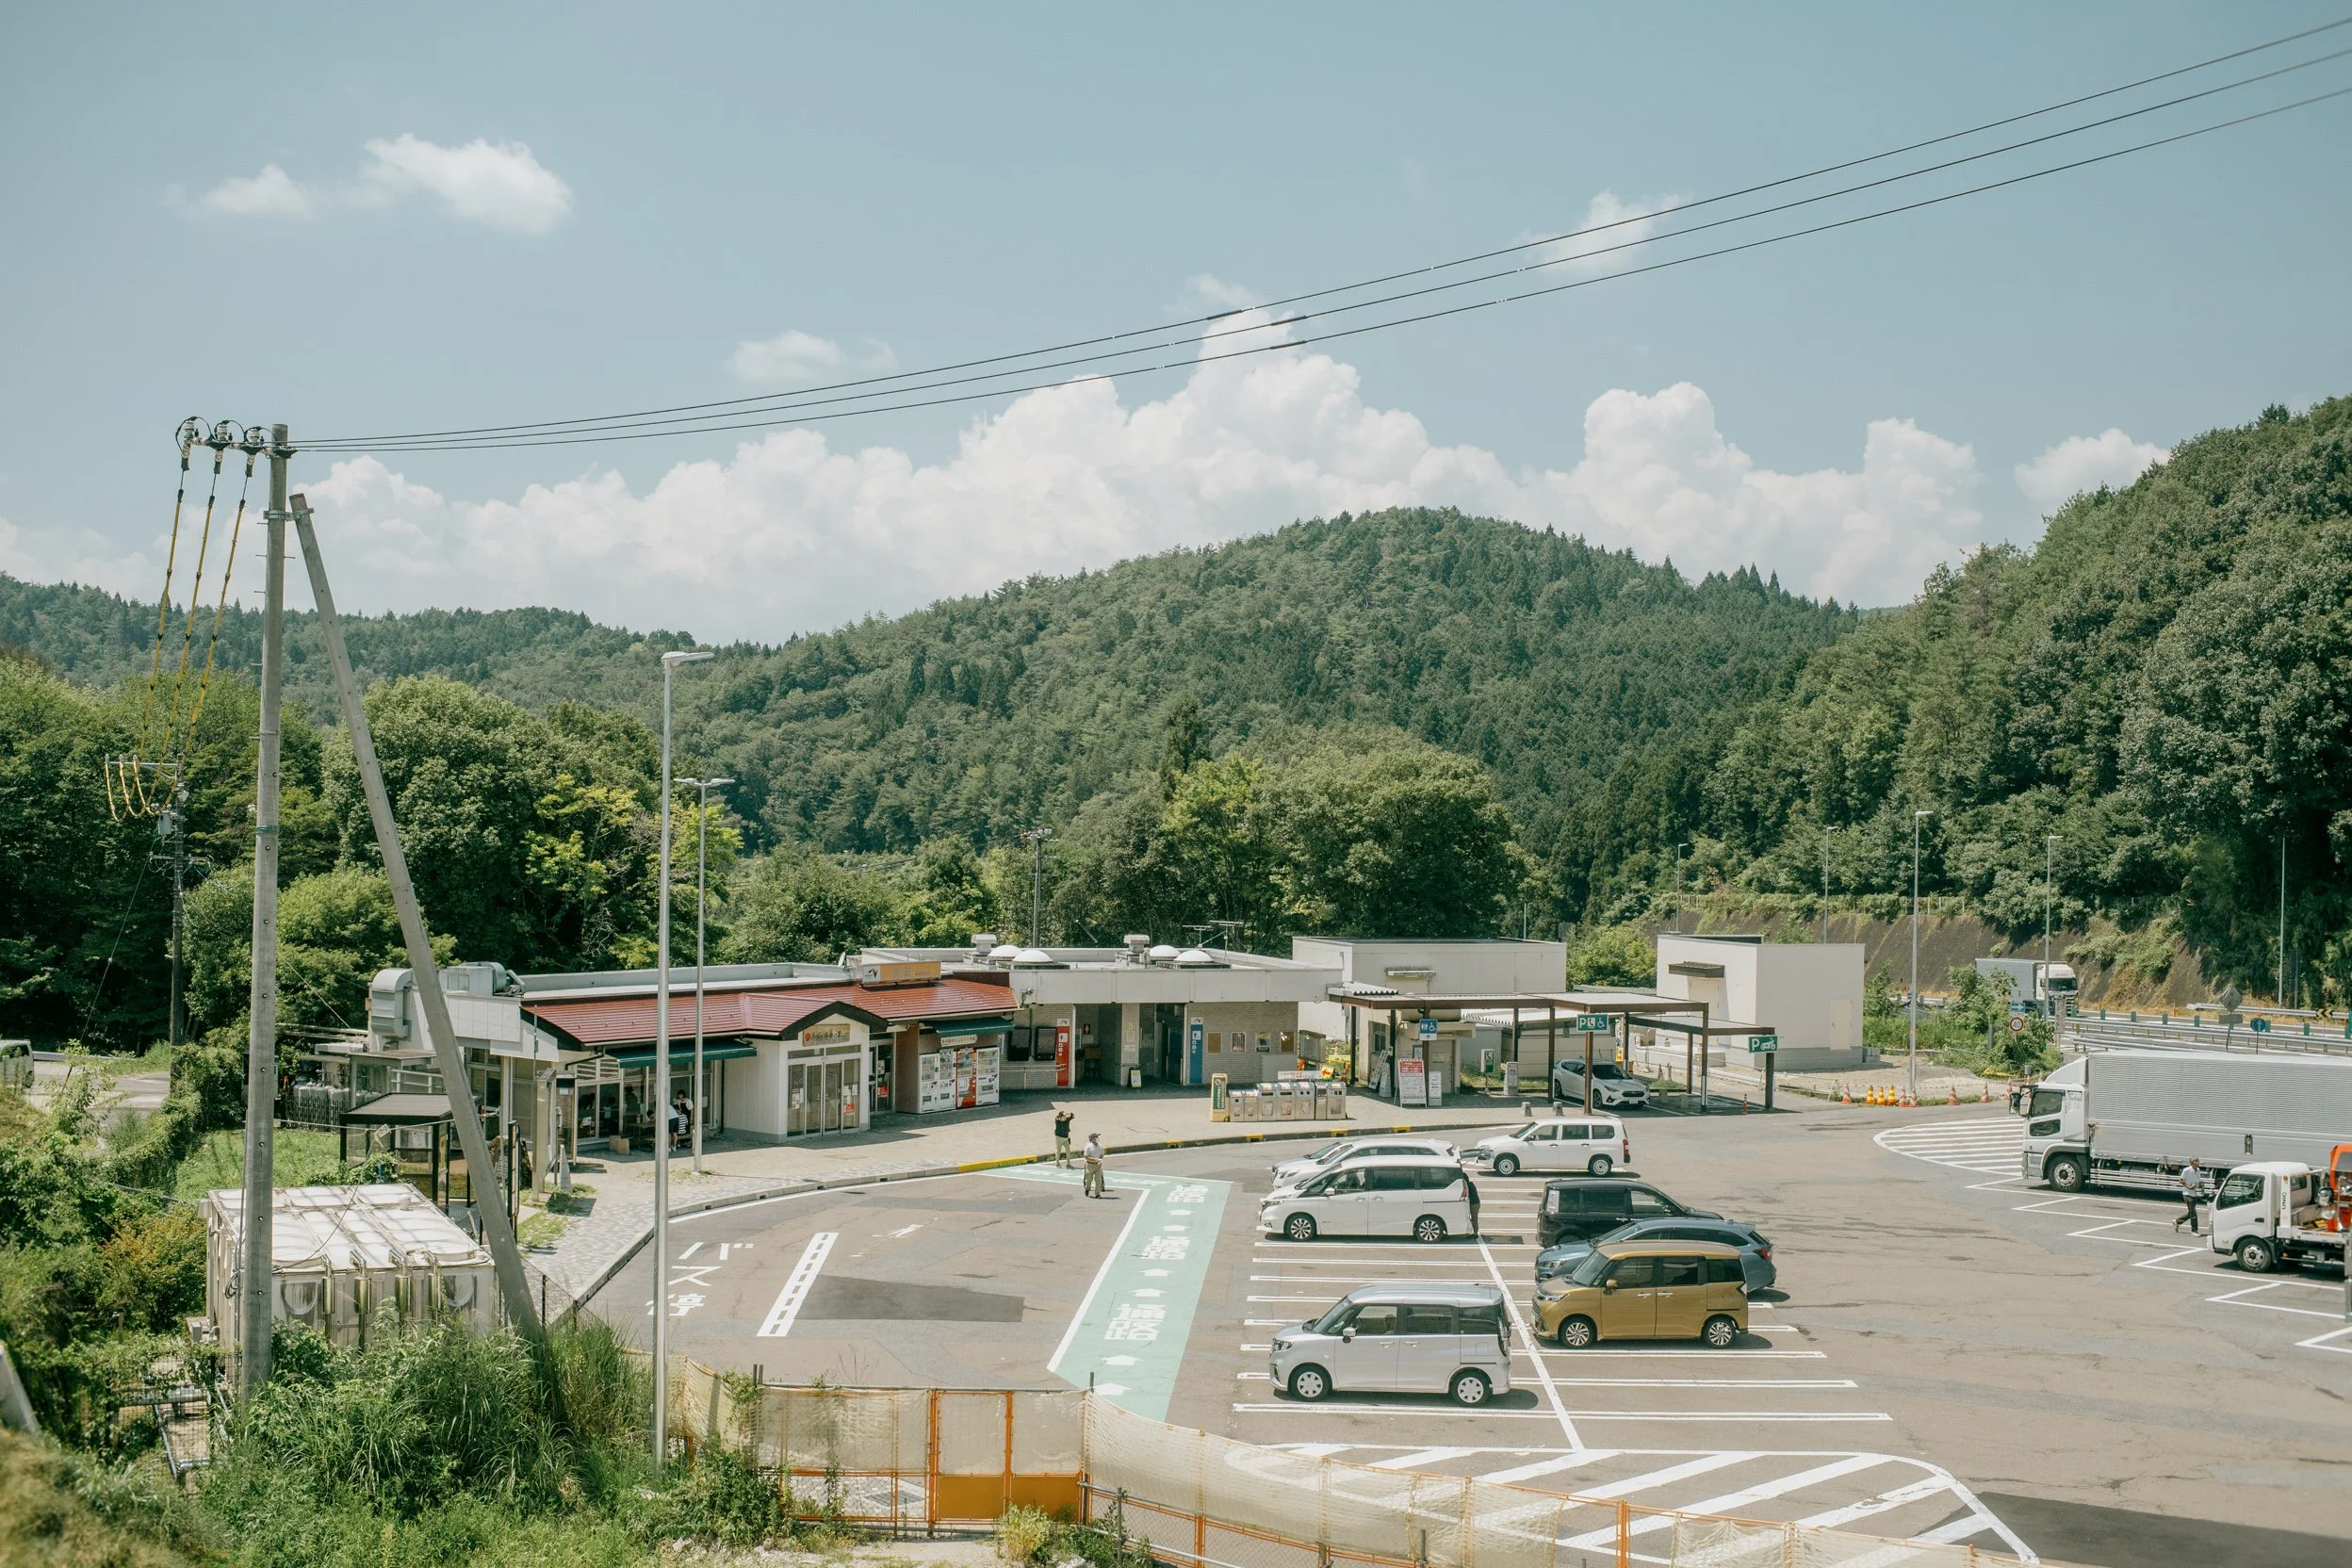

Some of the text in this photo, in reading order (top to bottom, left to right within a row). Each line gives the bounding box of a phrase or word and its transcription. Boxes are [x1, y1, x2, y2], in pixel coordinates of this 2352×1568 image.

[1579, 1017, 1586, 1028] P
[1752, 1038, 1759, 1052] P
[1141, 1235, 1191, 1260] 通路
[1103, 1303, 1168, 1341] 通路
